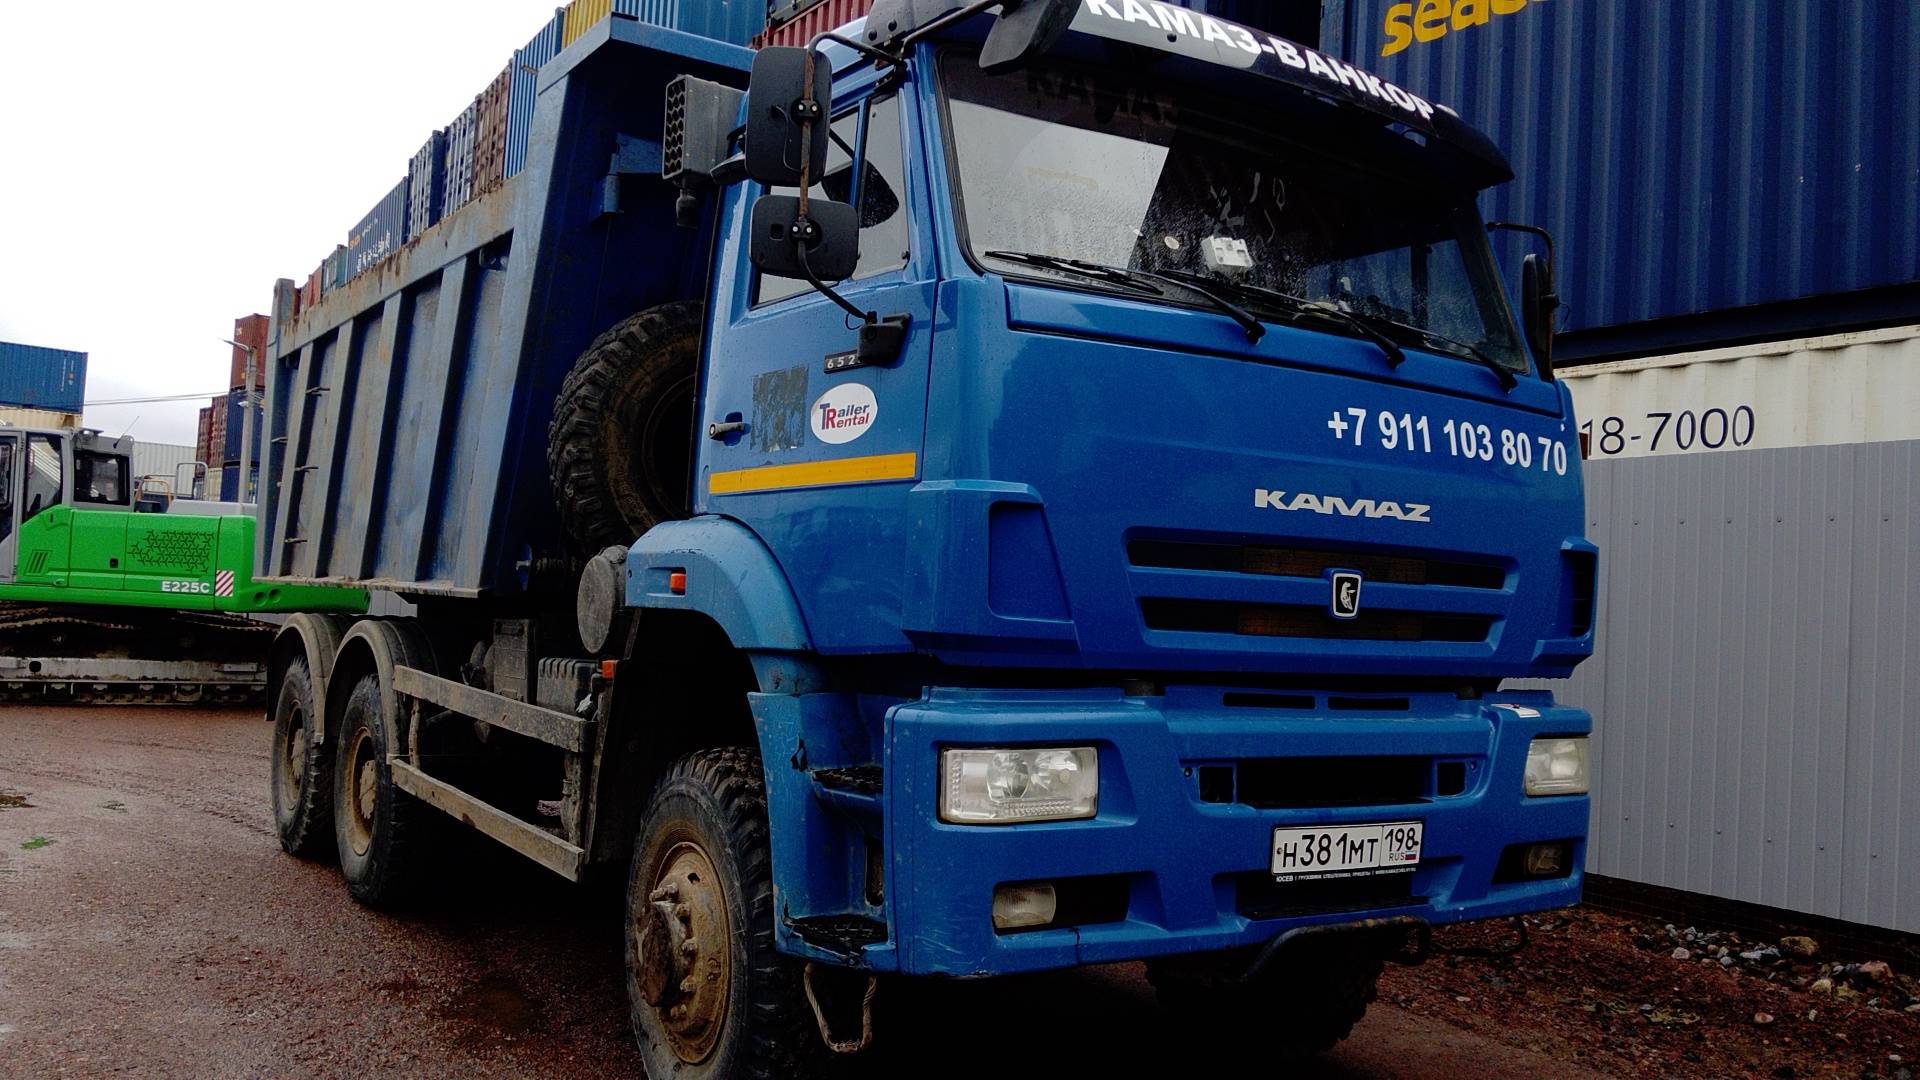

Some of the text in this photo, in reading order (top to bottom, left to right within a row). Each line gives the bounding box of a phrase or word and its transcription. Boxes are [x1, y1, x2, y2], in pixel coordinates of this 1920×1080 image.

[1328, 407, 1568, 476] +7 911 103 80 70
[1254, 488, 1431, 522] KAMAZ
[161, 581, 210, 593] E225C
[1282, 827, 1416, 868] Н381МТ 198
[1389, 853, 1405, 862] RUS
